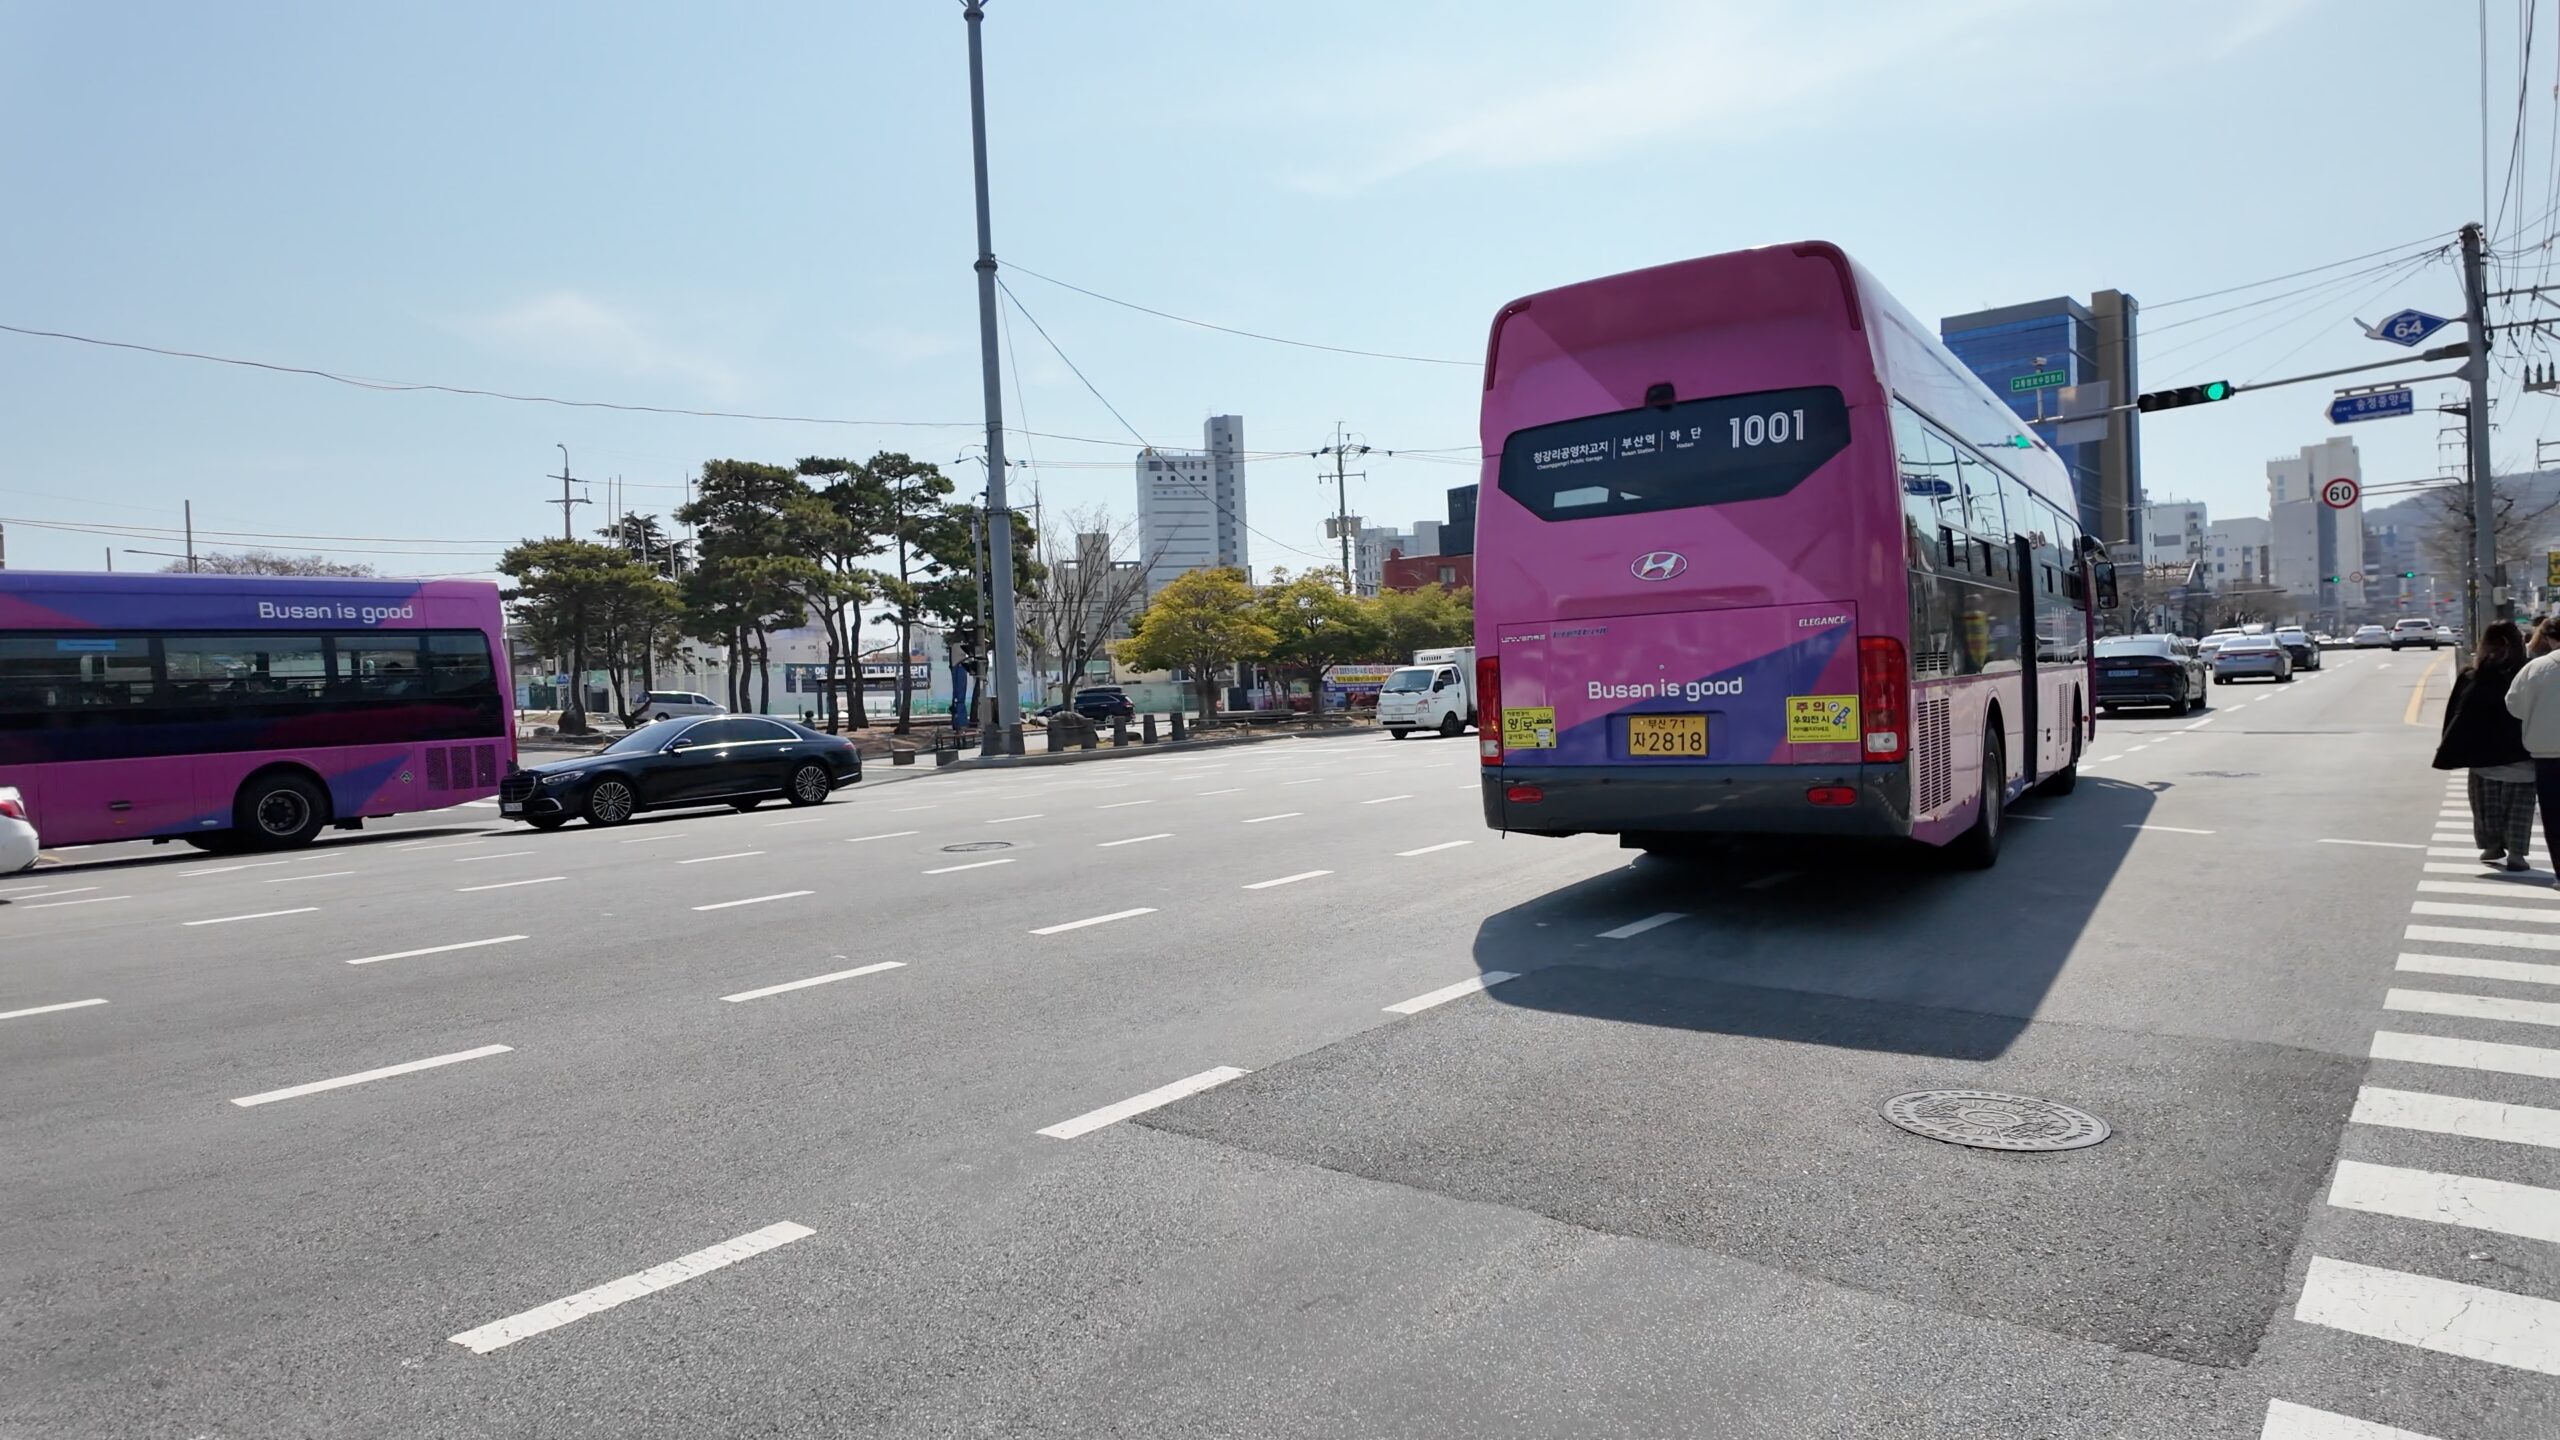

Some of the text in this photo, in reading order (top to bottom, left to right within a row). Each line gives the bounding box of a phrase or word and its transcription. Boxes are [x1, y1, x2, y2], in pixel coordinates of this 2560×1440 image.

[2394, 320, 2424, 338] 64
[1729, 409, 1804, 448] 1001
[1621, 434, 1656, 449] 부산역
[1533, 441, 1609, 464] 청강리공영차고지
[2330, 486, 2352, 501] 60
[259, 602, 414, 624] Busan is good
[1798, 615, 1847, 627] ELEGANCE
[1588, 677, 1743, 702] Busan is good
[1648, 719, 1685, 729] 부산 71
